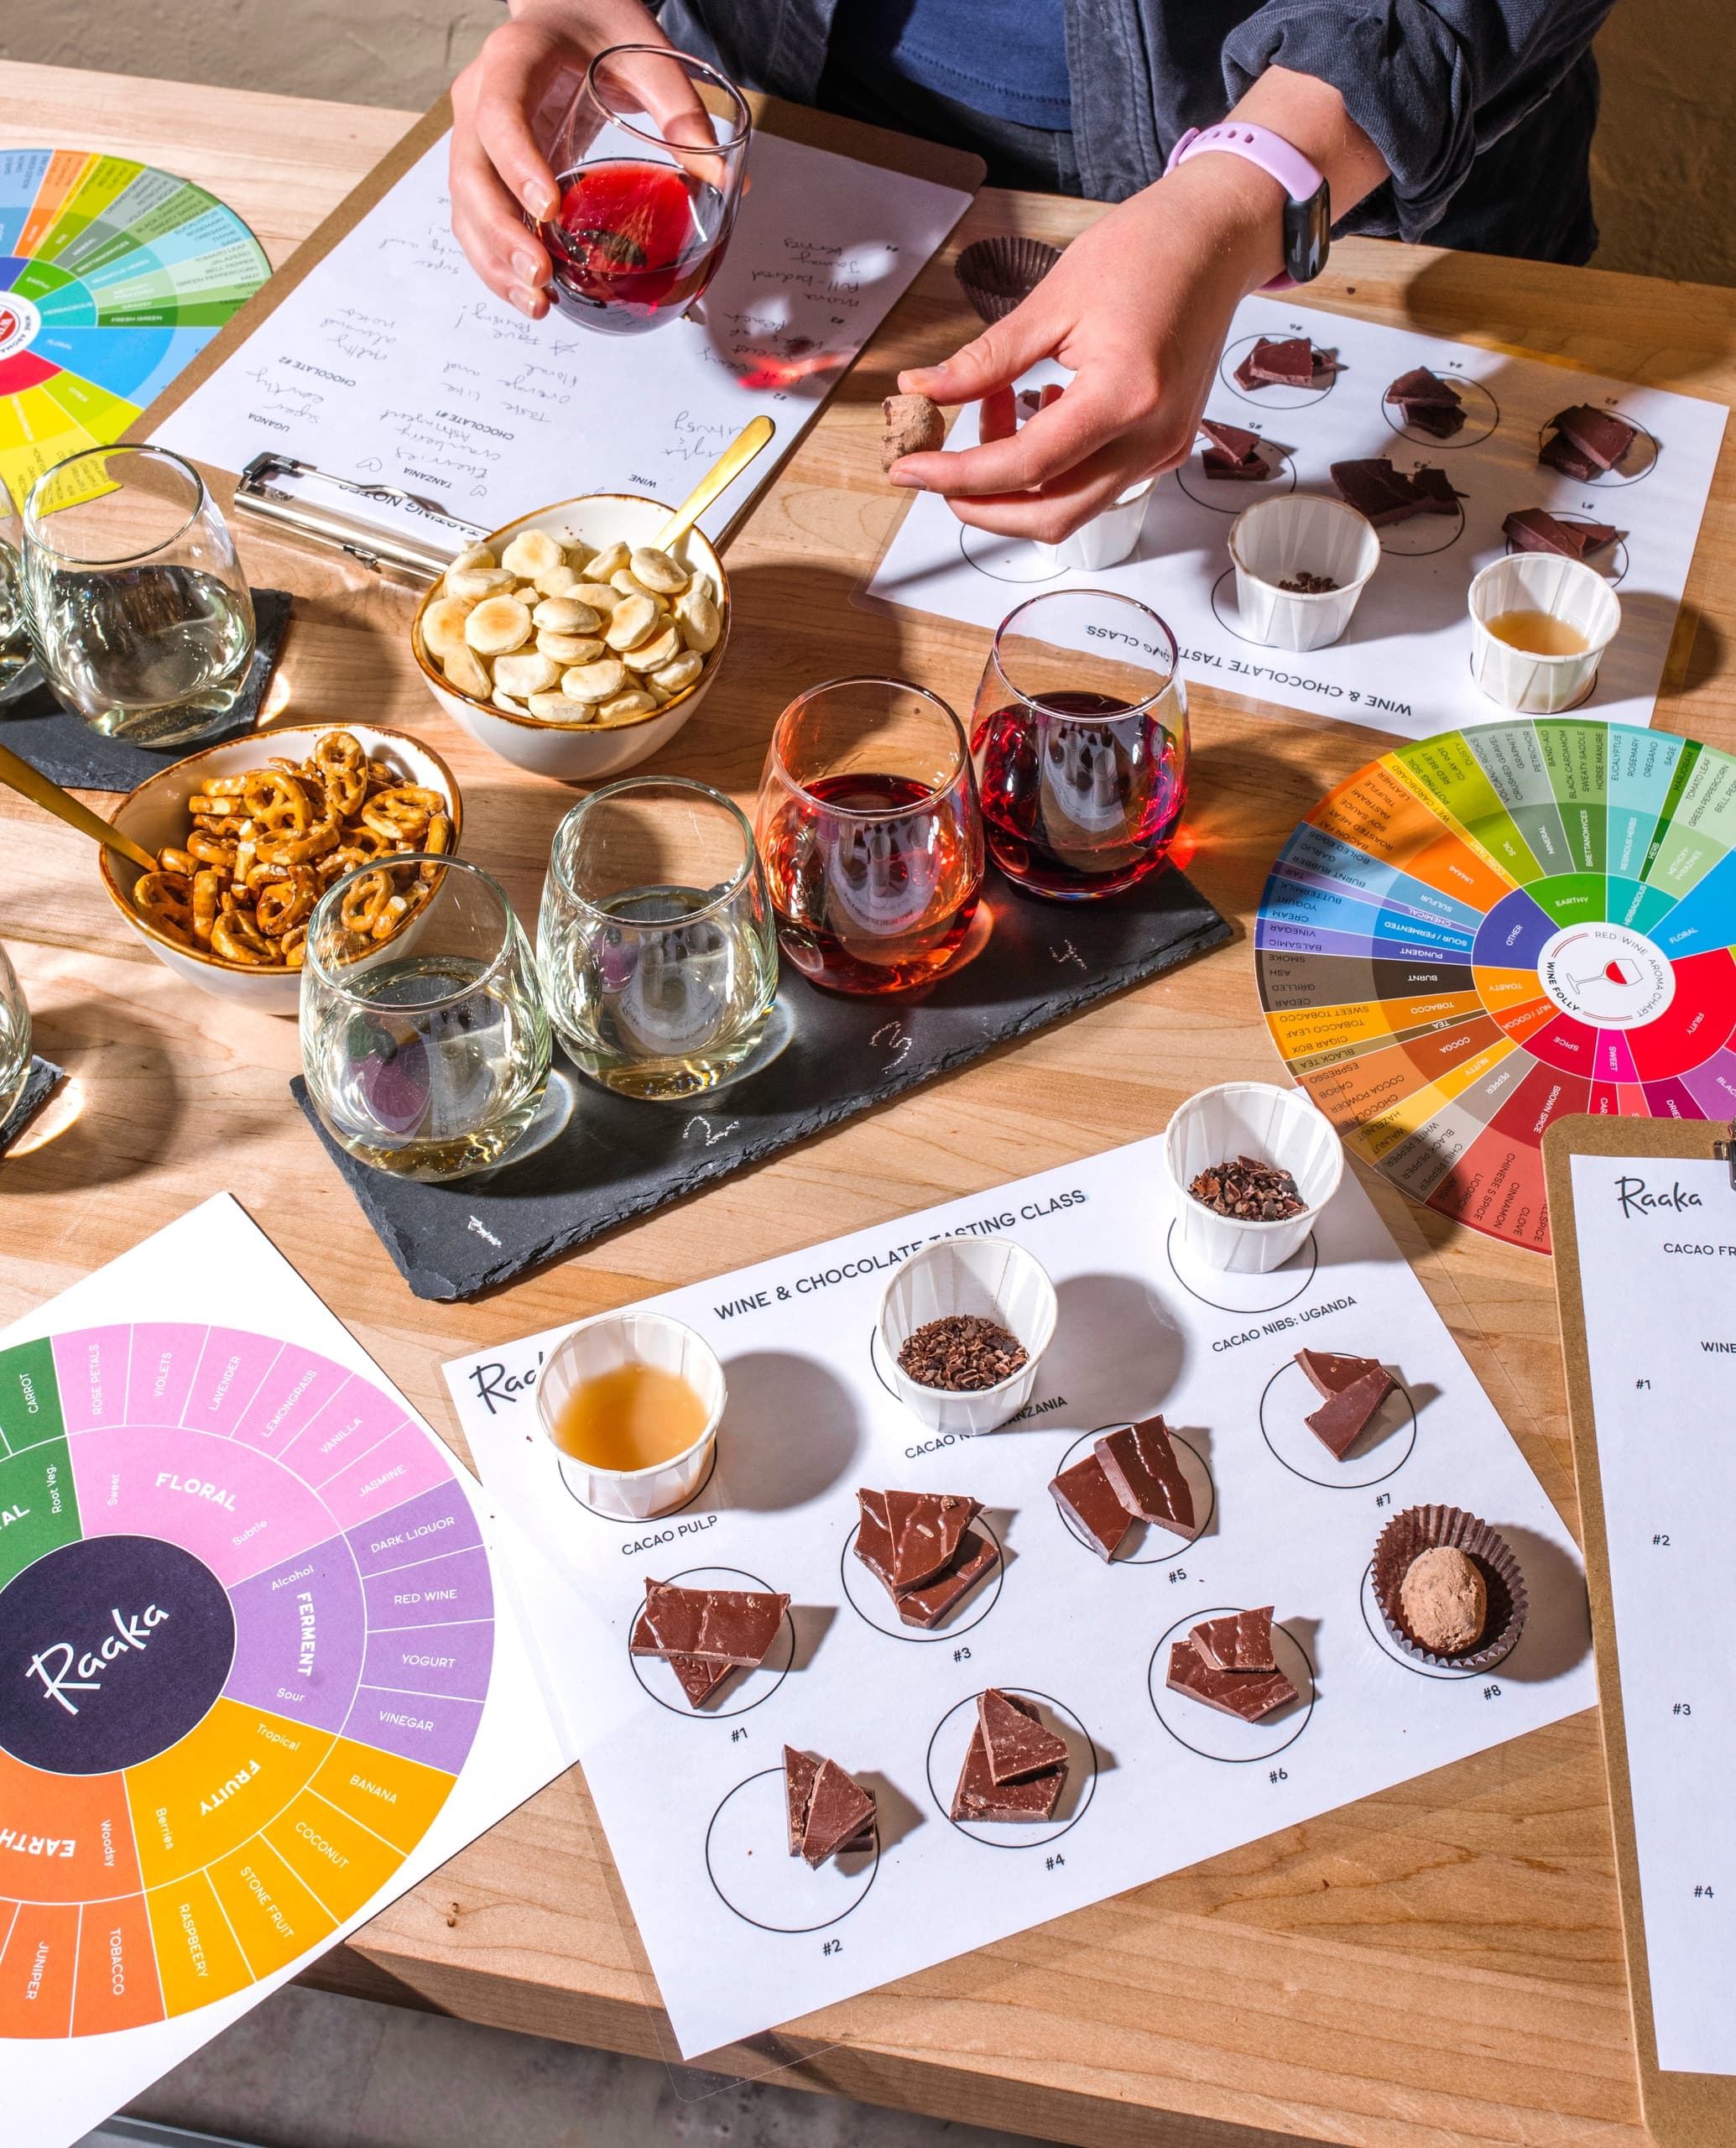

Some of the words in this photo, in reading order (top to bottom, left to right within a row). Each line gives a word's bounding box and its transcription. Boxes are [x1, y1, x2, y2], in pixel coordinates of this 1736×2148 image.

[279, 357, 294, 365] #2
[295, 361, 356, 387] CHOCOLATE
[248, 412, 289, 432] UGANDA
[455, 415, 514, 441] CHOCOLATE
[404, 467, 451, 488] TANZANIA
[629, 473, 656, 488] WINE
[1087, 625, 1139, 645] CLASS
[1228, 660, 1342, 696] CHOCOLATE
[1349, 691, 1361, 701] &
[1365, 696, 1411, 716] WINE
[1505, 733, 1525, 769] GRAPHITE
[1523, 731, 1541, 772] PETRICHOR
[1541, 730, 1555, 767] BAND-AID
[1559, 730, 1576, 773] CARDAMOM
[1577, 731, 1586, 760] SADDLE
[1595, 733, 1604, 764] MANURE
[1611, 734, 1622, 781] EUCALYPTUS
[1628, 738, 1639, 778] ROSEMARY
[1664, 746, 1677, 766] SAGE
[1643, 741, 1658, 778] OREGANO
[1377, 772, 1410, 800] LEATHER
[1567, 774, 1577, 799] BLACK
[1580, 762, 1590, 792] SWEATY
[1595, 766, 1604, 790] HORSE
[1364, 781, 1395, 806] TRUFFLE
[1539, 825, 1555, 855] MINERAL
[1579, 810, 1593, 867] BRETTANOMYCES
[1647, 842, 1660, 860] HERB
[1301, 843, 1336, 862] GARLIC
[1275, 897, 1316, 910] YOGURT
[1280, 882, 1342, 905] BUTTERMILK
[1420, 894, 1454, 913] SULFUR
[1555, 896, 1589, 908] EARTHY
[1624, 884, 1647, 926] HERBACEOUS
[1272, 910, 1309, 922] CREAM
[1408, 907, 1452, 927] CHEMICAL
[1269, 925, 1316, 937] VINEGAR
[1384, 921, 1435, 939] FERMENTED
[1444, 936, 1468, 947] SOUR
[1505, 925, 1523, 946] OTHER
[1595, 931, 1617, 941] RED
[1668, 927, 1698, 944] FLORAL
[1269, 940, 1322, 951] BALSAMIC
[1399, 947, 1444, 959] PUNGENT
[1622, 936, 1647, 956] WINE
[1407, 973, 1438, 982] BURNT
[1547, 962, 1557, 985] WINE
[1553, 987, 1580, 1011] FOLLY
[1648, 958, 1664, 991] AROMA
[1272, 983, 1315, 992] GRILLED
[1489, 983, 1523, 992] TOASTY
[1410, 1002, 1455, 1014] TOBACCO
[1637, 991, 1661, 1018] CHART
[1431, 1019, 1451, 1029] TEA
[1686, 1012, 1704, 1035] FRUITY
[868, 1020, 913, 1073] 3
[1439, 1037, 1471, 1053] COCOA
[1553, 1036, 1579, 1051] SPICE
[1608, 1045, 1618, 1072] SWEET
[1309, 1062, 1359, 1083] ESPRESSO
[1485, 1071, 1509, 1094] PEPPER
[1546, 1086, 1561, 1112] BROWN
[681, 1115, 741, 1148] 2
[1534, 1111, 1549, 1134] SPICE
[1455, 1172, 1484, 1212] LICORICE
[1614, 1176, 1702, 1217] Raaka
[1494, 1182, 1520, 1229] CINNAMON
[1513, 1207, 1530, 1236] CLOVE
[713, 1291, 771, 1321] WINE
[776, 1285, 792, 1301] &
[1020, 1190, 1087, 1220] CLASS
[1664, 1243, 1713, 1255] CACAO
[1212, 1329, 1260, 1353] CACAO
[1262, 1316, 1298, 1341] NIBS:
[1301, 1296, 1357, 1325] UGANDA
[89, 1343, 101, 1384] PETALS
[154, 1352, 173, 1398] VIOLETS
[19, 1373, 39, 1414] CARROT
[207, 1355, 242, 1411] LAVENDER
[1635, 1379, 1651, 1389] #1
[92, 1389, 103, 1415] ROSE
[261, 1368, 318, 1439] LEMONGRASS
[318, 1417, 363, 1456] VANILLA
[904, 1434, 955, 1459] CACAO
[47, 1464, 56, 1487] Veg.
[357, 1464, 407, 1499] JASMINE
[51, 1488, 62, 1514] Root
[107, 1473, 121, 1507] Sweet
[154, 1472, 237, 1512] FLORAL
[1376, 1494, 1393, 1507] #7
[232, 1520, 268, 1547] Subtle
[370, 1533, 404, 1553] DARK
[405, 1516, 456, 1542] LIQUOR
[622, 1530, 675, 1556] CACAO
[678, 1515, 717, 1538] PULP
[1652, 1535, 1671, 1546] #2
[270, 1564, 315, 1592] Alcohol
[1168, 1568, 1187, 1584] #5
[394, 1593, 420, 1606] RED
[424, 1588, 458, 1602] WINE
[296, 1592, 316, 1677] FERMENT
[24, 1604, 170, 1717] Raaka
[401, 1654, 456, 1669] YOGURT
[952, 1648, 972, 1662] #3
[277, 1687, 305, 1702] Sour
[1483, 1685, 1502, 1701] #8
[378, 1711, 434, 1732] VINEGAR
[1672, 1704, 1692, 1716] #3
[256, 1723, 301, 1752] Tropical
[731, 1727, 748, 1743] #1
[200, 1760, 261, 1817] FRUITY
[1269, 1768, 1289, 1785] #6
[349, 1775, 398, 1805] BANANA
[155, 1807, 174, 1849] Berries
[101, 1819, 115, 1867] Woodsy
[295, 1821, 350, 1870] COCONUT
[1045, 1854, 1066, 1871] #4
[240, 1866, 272, 1905] STONE
[265, 1902, 295, 1939] FRUIT
[1693, 1886, 1714, 1899] #4
[178, 1903, 209, 1979] RASPBEERY
[822, 1941, 842, 1957] #2
[25, 1941, 50, 2000] JUNIPER
[109, 1927, 124, 1995] TOBACCO
